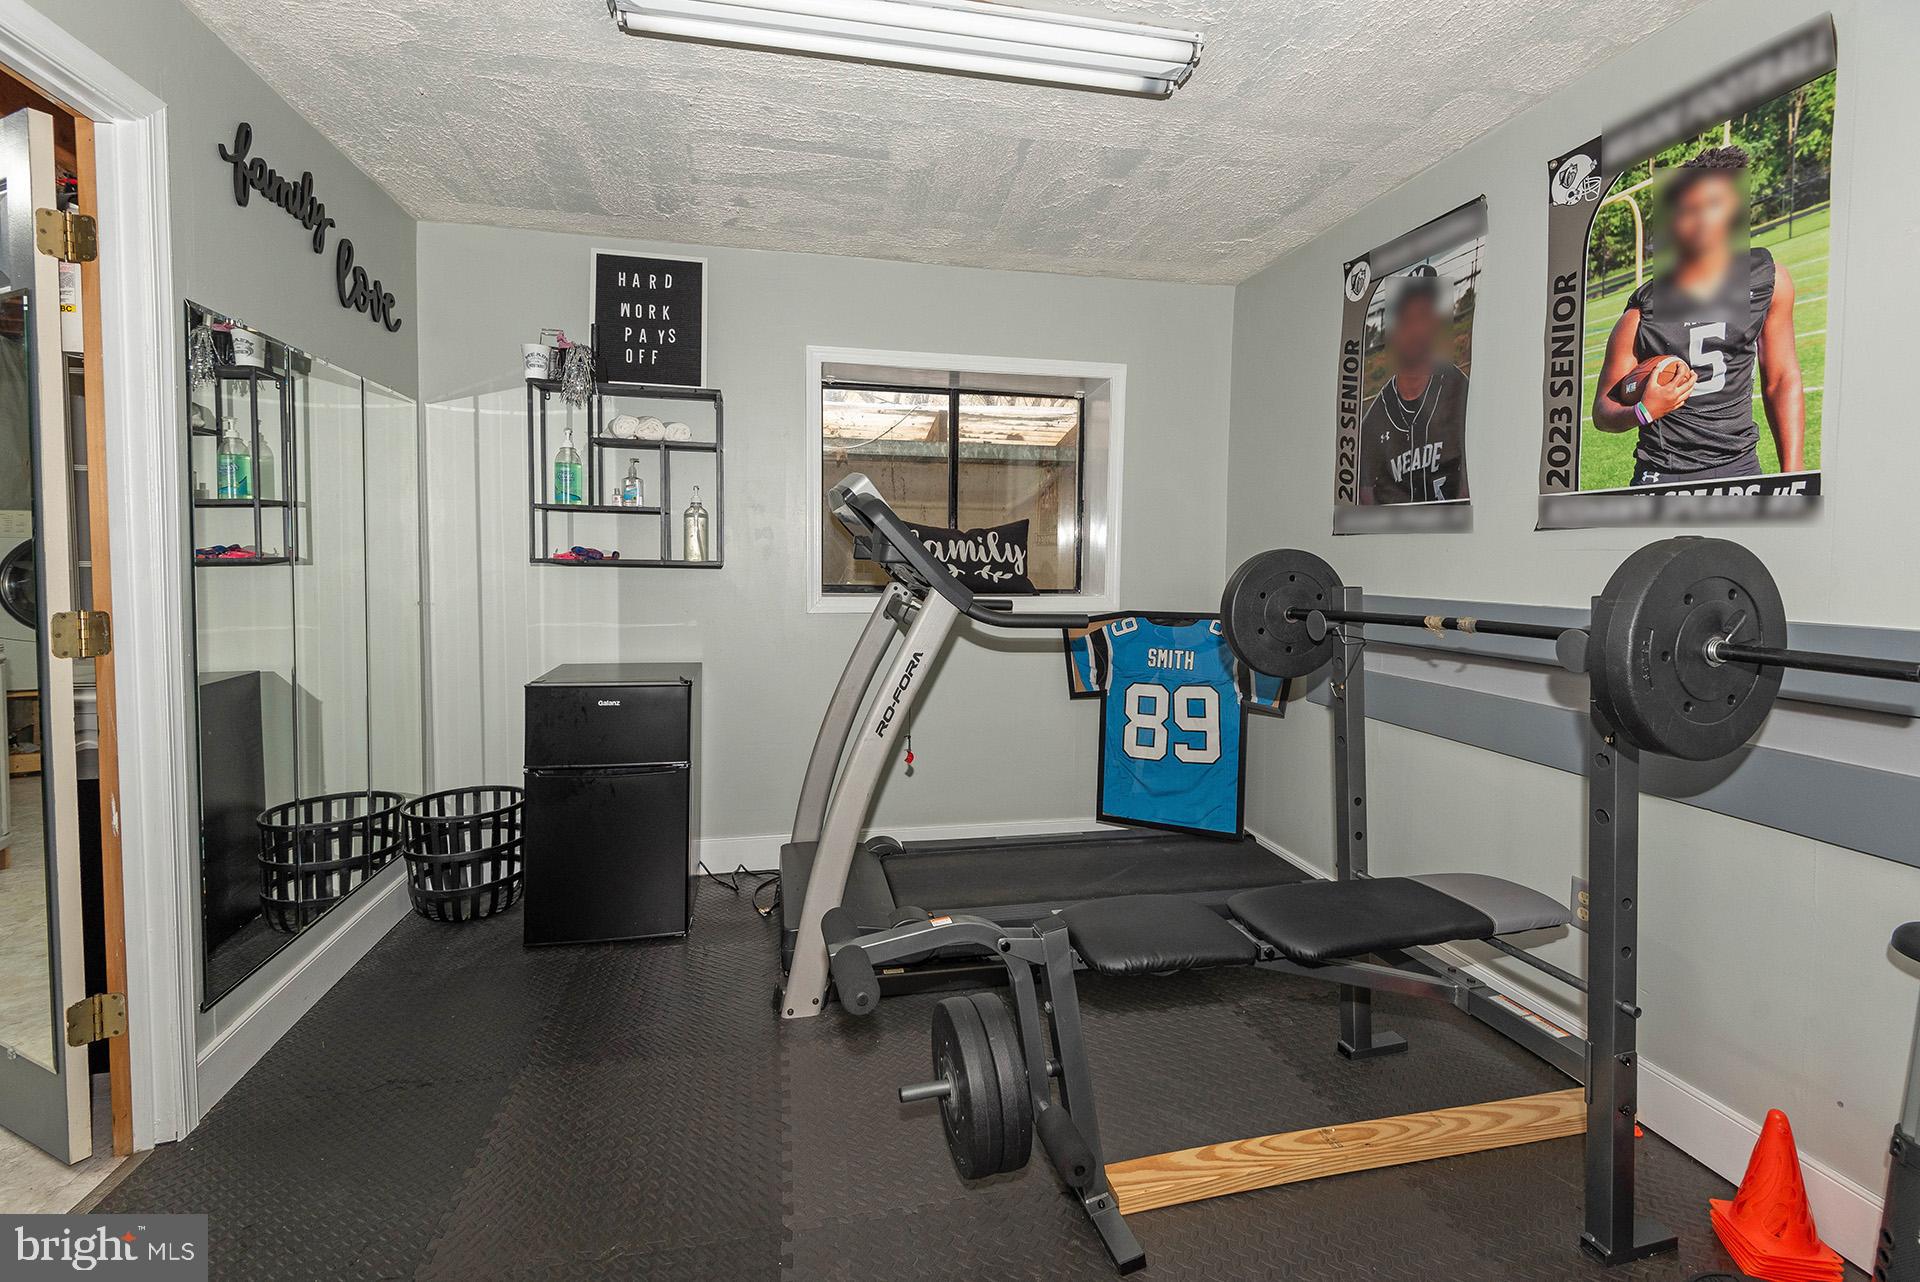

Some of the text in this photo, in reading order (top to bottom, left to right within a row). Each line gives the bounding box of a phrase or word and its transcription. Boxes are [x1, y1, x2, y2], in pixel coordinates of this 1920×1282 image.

[218, 122, 402, 332] family love
[618, 272, 672, 289] HARD
[621, 303, 670, 320] WORK
[625, 327, 676, 344] PAYS
[626, 348, 658, 364] OFF
[1546, 271, 1578, 488] 2023 SENIOR
[1689, 322, 1727, 397] 5
[1338, 339, 1361, 502] 2023 SENIOR
[1390, 441, 1443, 483] MEADE
[910, 531, 1026, 576] amily
[1147, 648, 1195, 671] SMITH
[1123, 682, 1222, 764] 89
